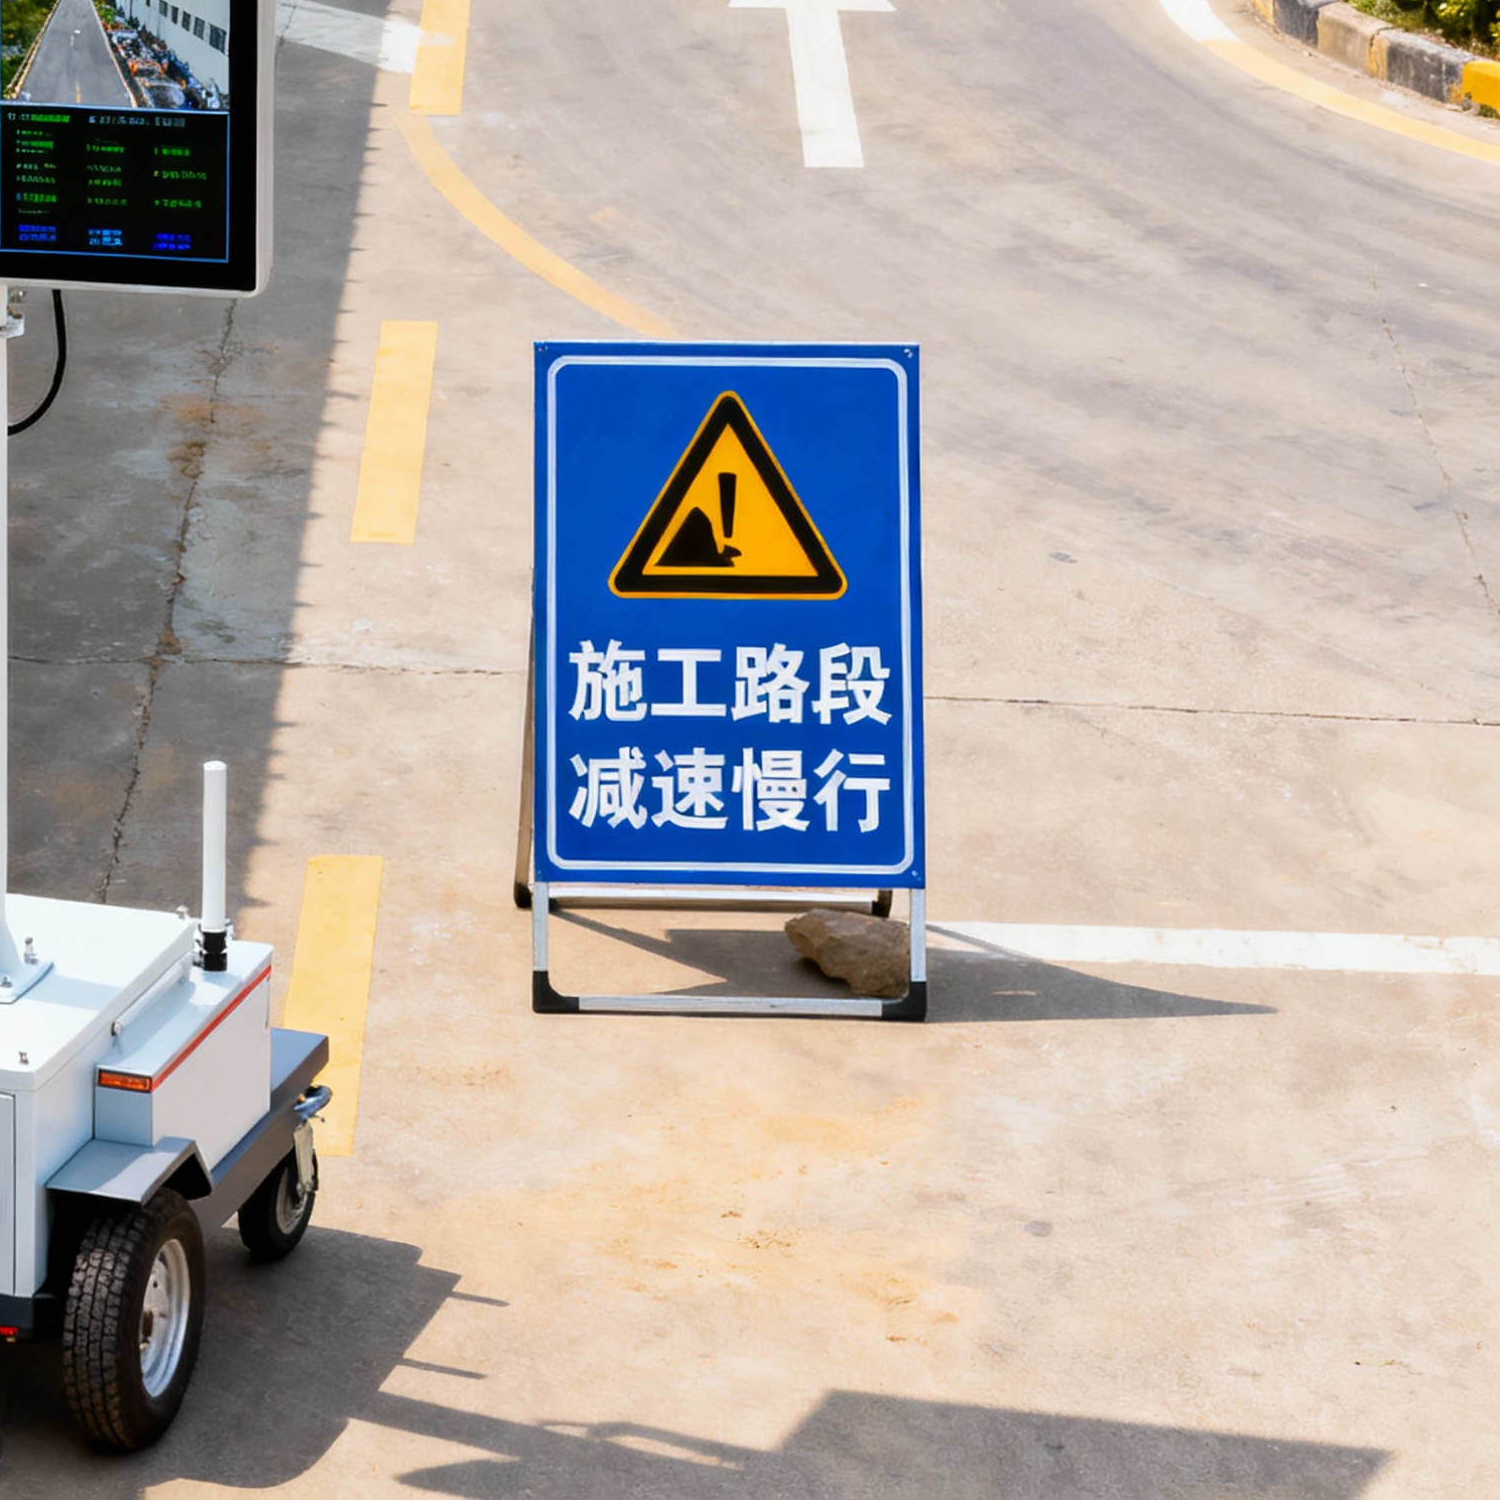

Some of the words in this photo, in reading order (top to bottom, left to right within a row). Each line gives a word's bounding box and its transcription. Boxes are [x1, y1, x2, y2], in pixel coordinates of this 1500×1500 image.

[569, 639, 892, 725] 施工路段
[569, 746, 891, 833] 减速慢行
